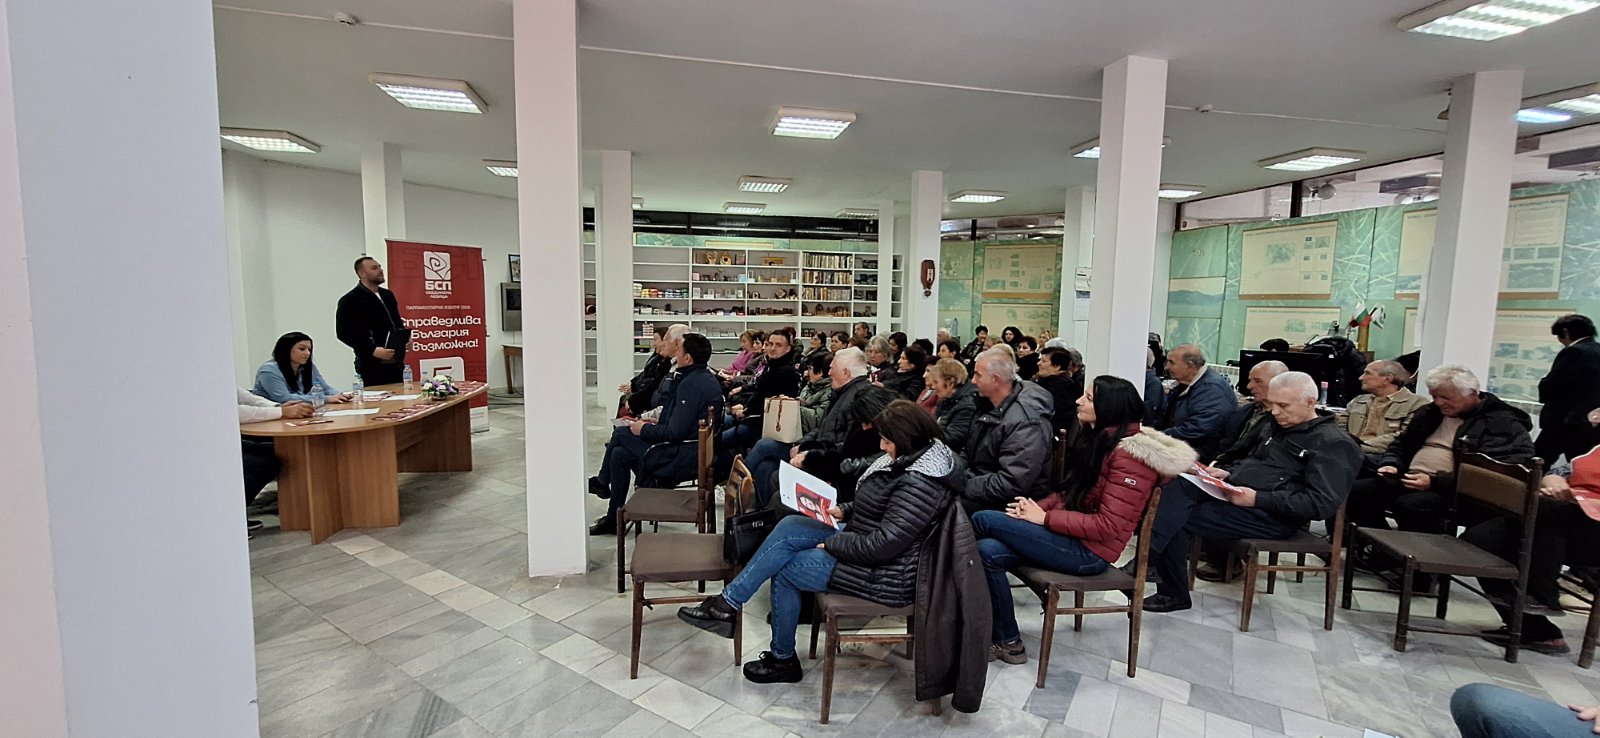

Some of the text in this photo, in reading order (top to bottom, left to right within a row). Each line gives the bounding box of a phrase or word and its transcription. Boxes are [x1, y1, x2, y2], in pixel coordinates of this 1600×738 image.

[425, 280, 452, 291] БСП
[410, 329, 469, 339] България
[412, 338, 479, 352] възможна!
